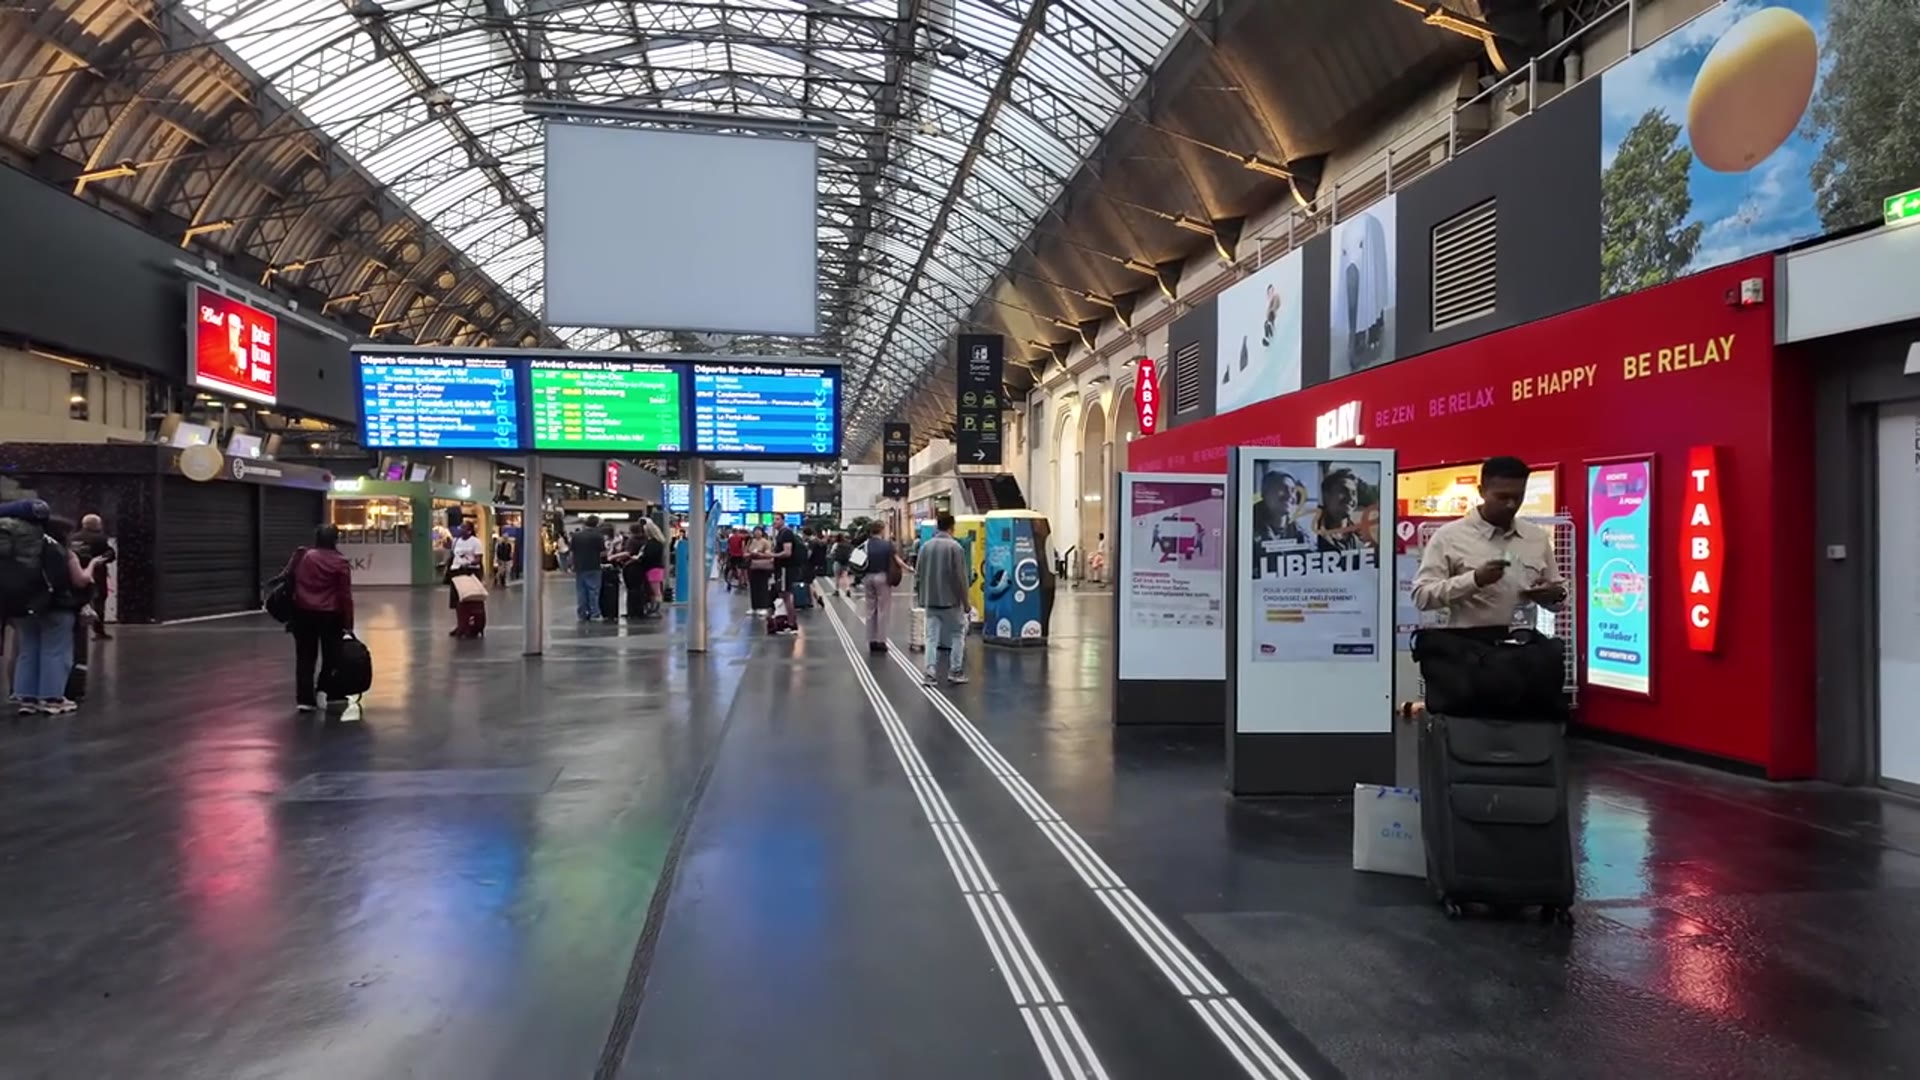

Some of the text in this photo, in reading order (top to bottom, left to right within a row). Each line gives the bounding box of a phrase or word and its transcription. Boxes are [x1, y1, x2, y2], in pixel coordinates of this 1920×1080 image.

[360, 355, 396, 366] Départs
[397, 357, 434, 366] Grandes
[435, 358, 464, 368] Lignes
[530, 360, 566, 369] Arrivées
[567, 361, 602, 370] Grandes
[603, 362, 632, 372] Lignes
[694, 365, 727, 375] Départs
[1623, 335, 1735, 381] BE RELAY
[415, 384, 445, 392] Colmar
[583, 388, 626, 398] Strasbourg
[1511, 364, 1598, 402] BE HAPPY
[377, 391, 414, 400] Strasbourg
[1141, 366, 1153, 427] TABAC
[1428, 386, 1495, 418] BE RELAX
[811, 388, 830, 453] départs
[1375, 404, 1416, 428] BE ZEN
[1690, 469, 1711, 628] TABAC
